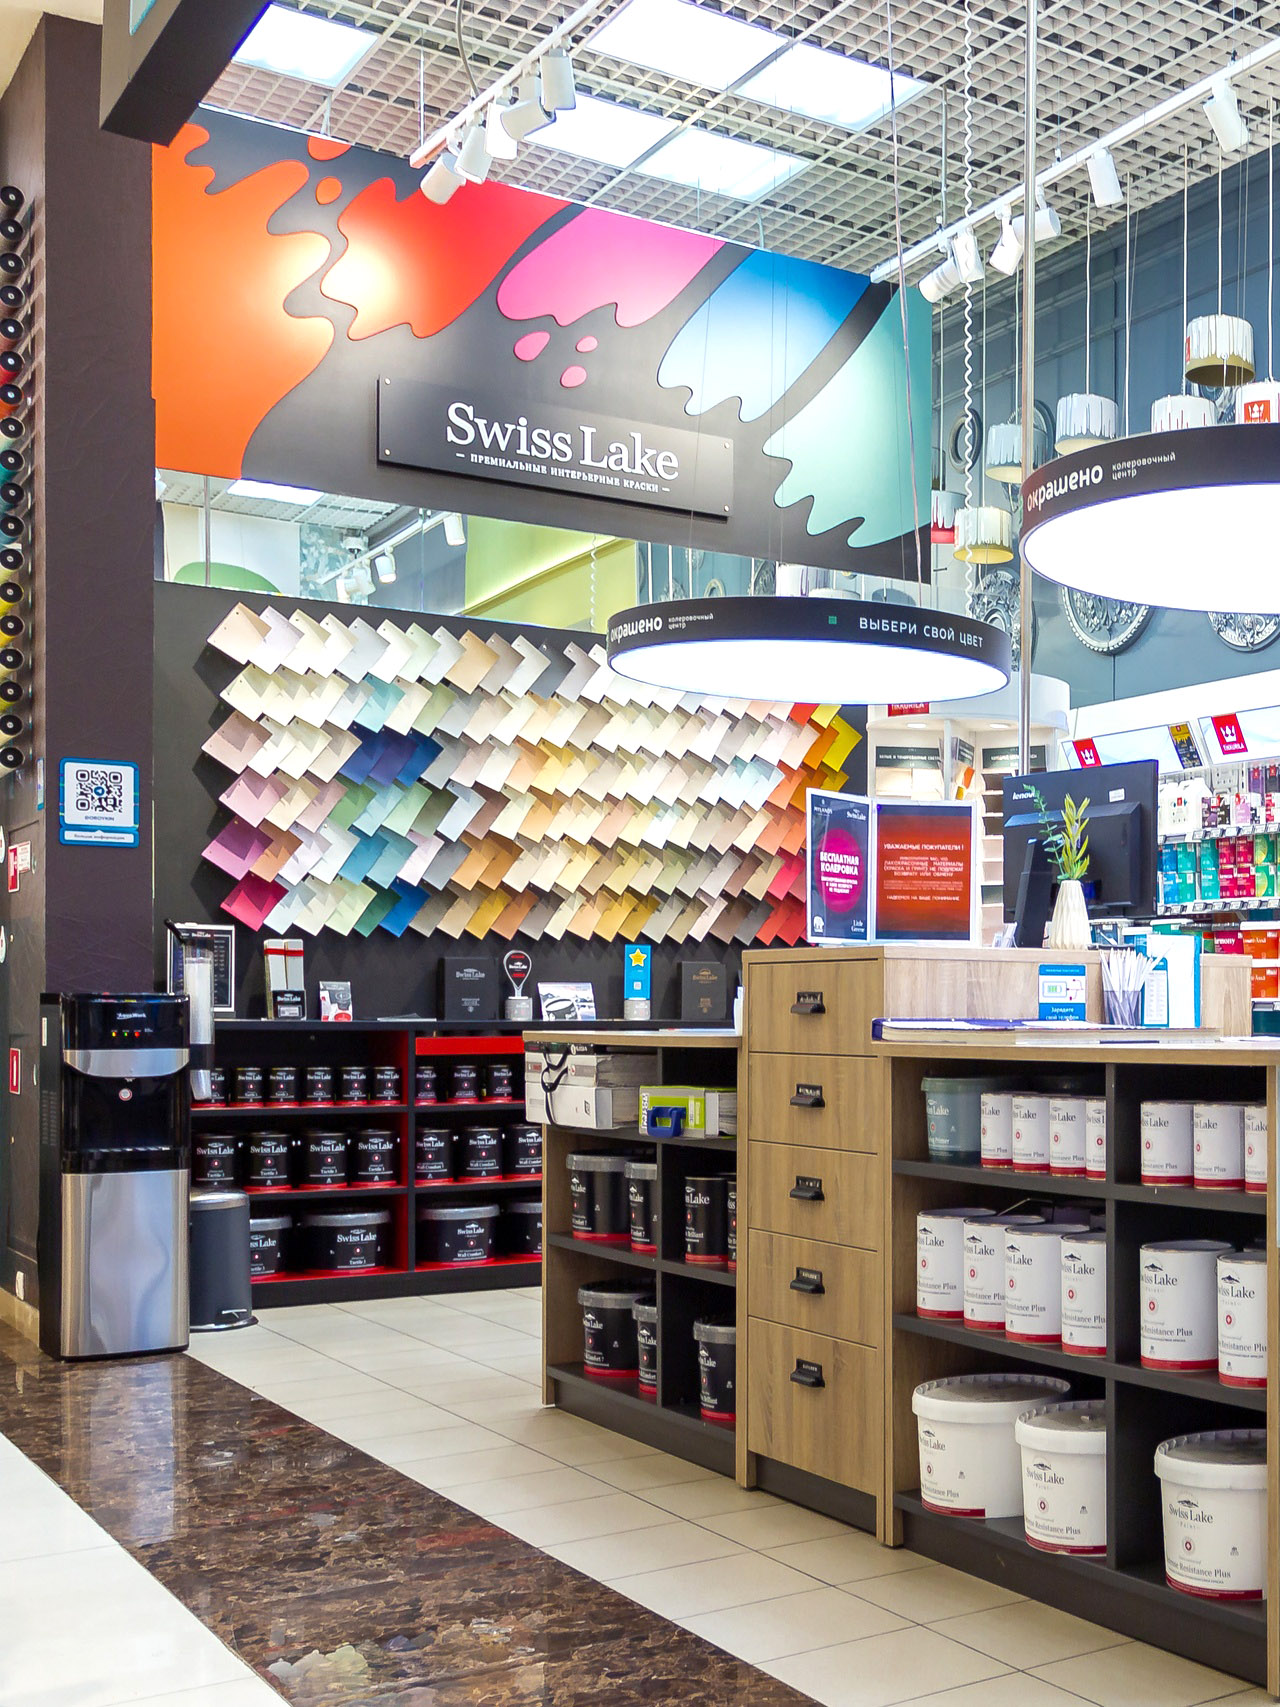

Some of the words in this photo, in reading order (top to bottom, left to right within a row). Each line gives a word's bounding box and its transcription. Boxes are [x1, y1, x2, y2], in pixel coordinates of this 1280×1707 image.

[446, 402, 572, 461] Swiss
[580, 426, 679, 480] Lake
[1112, 452, 1176, 471] колеровочный
[470, 453, 547, 474] ПРЕМИАЛЬНЫЕ
[551, 466, 620, 486] ИНТЕРЬЕРНЫЕ
[623, 479, 658, 493] КРАСКИ
[1112, 468, 1137, 480] центр
[1027, 465, 1103, 511] окрашено
[668, 613, 714, 624] колеровочный
[611, 616, 663, 643] окрашено
[668, 621, 687, 630] центр
[860, 617, 917, 635] ВЫБЕРИ
[923, 625, 954, 641] СВОЙ
[959, 632, 983, 648] ЦВЕТ
[1223, 742, 1244, 751] TIKKURILA
[820, 852, 859, 865] БЕСПЛАТНАЯ
[821, 862, 858, 875] КОЛЕРОВКА
[934, 1106, 949, 1116] Lake
[985, 1107, 1000, 1116] Lake
[1019, 1109, 1036, 1119] Lake
[1058, 1112, 1076, 1122] Lake
[1150, 1117, 1169, 1128] Lake
[1200, 1119, 1217, 1129] Lake
[196, 1147, 217, 1155] Swiss
[218, 1146, 234, 1154] Lake
[250, 1145, 270, 1153] Swiss
[271, 1144, 287, 1153] Lake
[310, 1144, 329, 1152] Swiss
[330, 1143, 345, 1152] Lake
[358, 1142, 377, 1150] Swiss
[378, 1141, 393, 1150] Lake
[690, 1193, 709, 1204] Lake
[259, 1238, 276, 1247] Lake
[337, 1234, 360, 1243] Swiss
[361, 1233, 377, 1242] Lake
[925, 1236, 945, 1247] Lake
[975, 1245, 995, 1256] Lake
[1013, 1255, 1032, 1265] Lake
[1073, 1264, 1095, 1275] Lake
[1154, 1274, 1178, 1286] Lake
[1231, 1286, 1255, 1299] Lake
[1031, 1304, 1046, 1312] Plus
[930, 1439, 946, 1451] Lake
[1026, 1469, 1043, 1482] Swiss
[1044, 1473, 1064, 1485] Lake
[947, 1490, 959, 1498] Plus
[1169, 1503, 1188, 1520] Swiss
[1190, 1509, 1213, 1524] Lake
[1035, 1521, 1064, 1534] Resistance
[1066, 1526, 1081, 1535] Plus
[1179, 1562, 1212, 1577] Resistance
[1215, 1568, 1231, 1578] Plus
